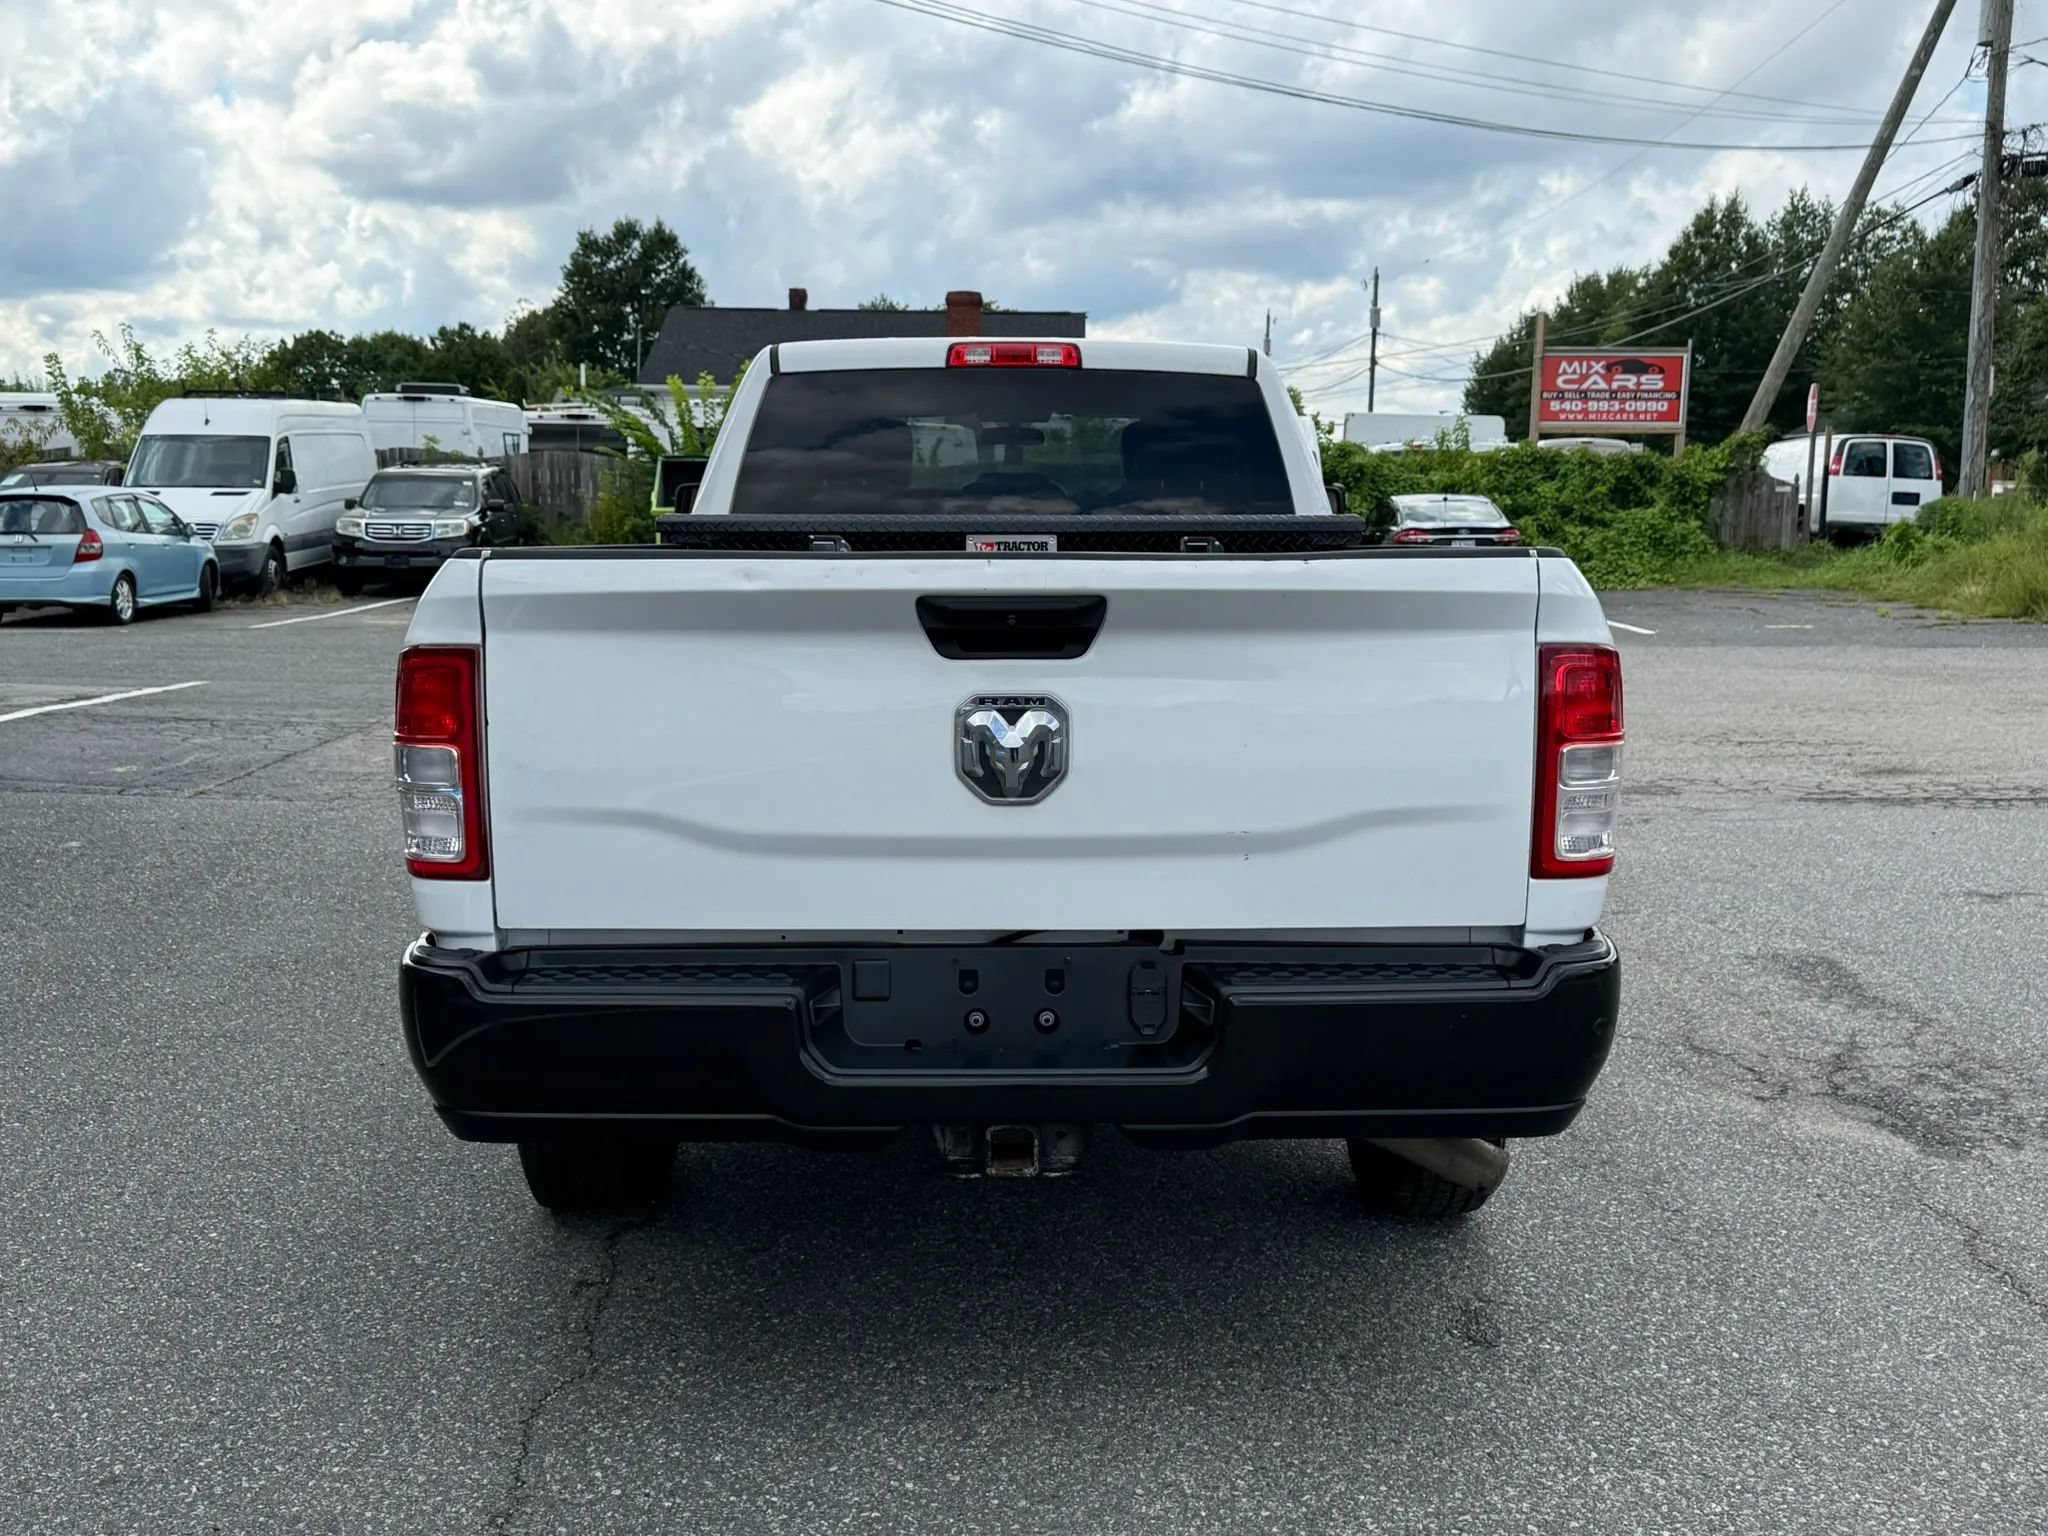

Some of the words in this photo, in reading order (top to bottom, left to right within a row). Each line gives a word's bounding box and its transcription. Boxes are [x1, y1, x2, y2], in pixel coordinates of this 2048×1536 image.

[1558, 360, 1607, 374] MIX
[1556, 374, 1665, 390] CARS
[1542, 391, 1557, 399] BUY
[1564, 391, 1580, 399] SELL
[1587, 391, 1610, 399] TRADE
[1616, 391, 1635, 399] EASY
[1636, 391, 1677, 399] FINANCING
[1558, 413, 1658, 421] WWW.MIXCARS.NET
[996, 541, 1049, 551] TRACTOR
[978, 697, 1046, 705] RAM
